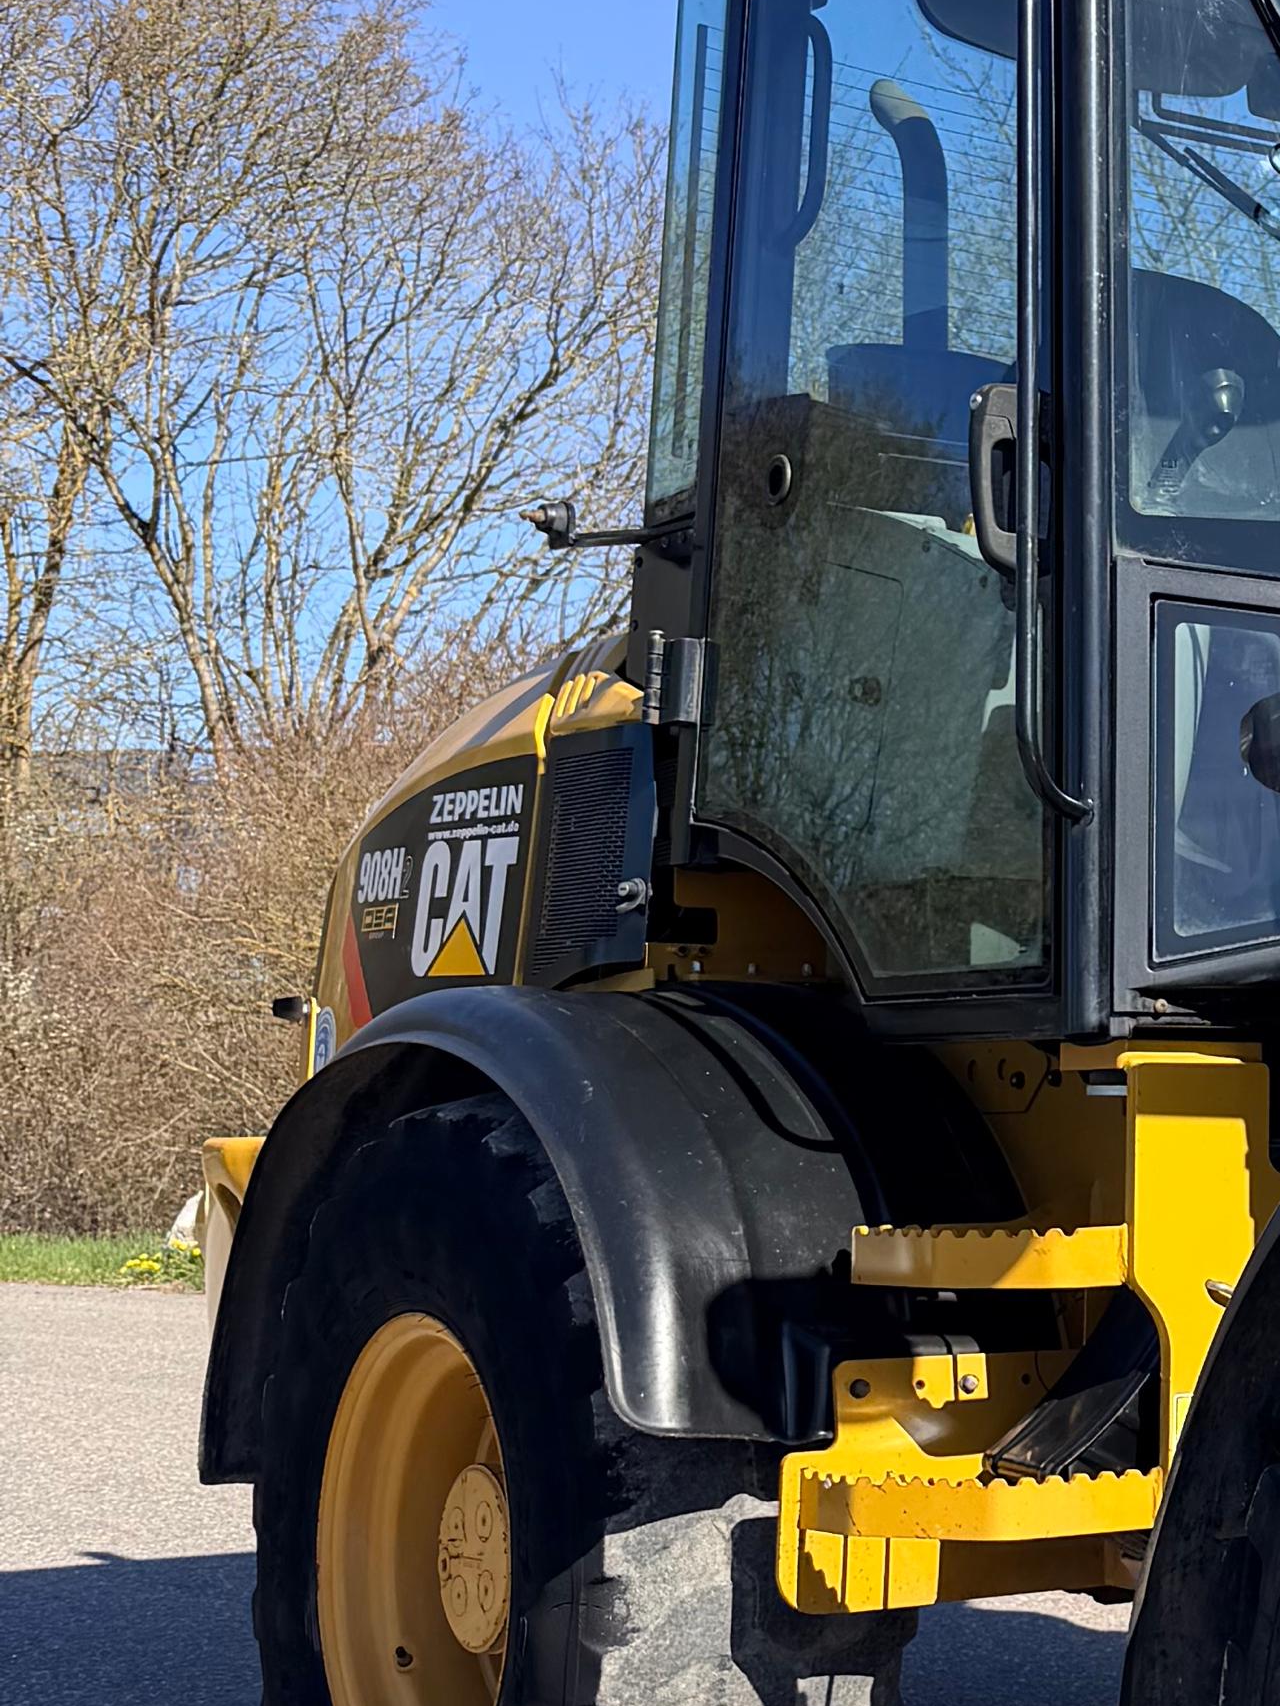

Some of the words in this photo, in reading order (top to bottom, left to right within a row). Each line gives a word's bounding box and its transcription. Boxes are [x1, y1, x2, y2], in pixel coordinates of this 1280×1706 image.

[429, 784, 524, 824] ZEPPELIN
[427, 820, 520, 841] www.zeppelin-cat.de
[410, 835, 520, 978] CAT
